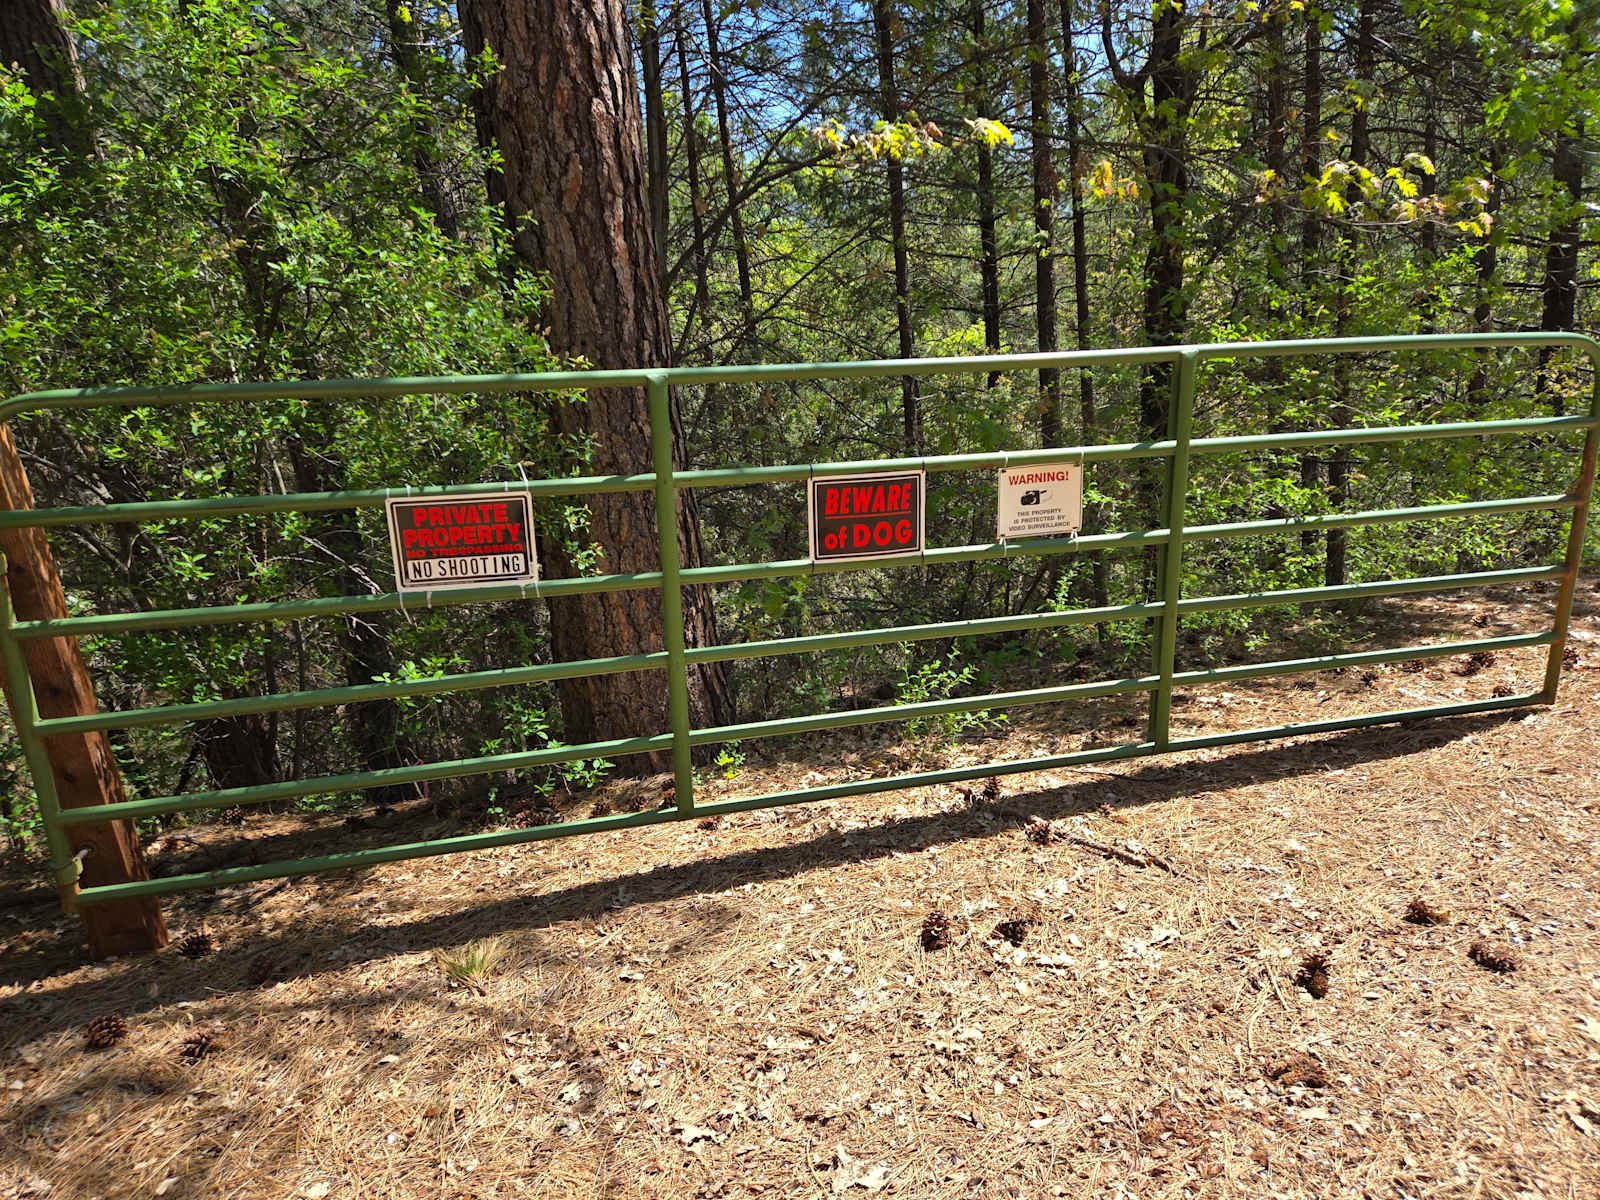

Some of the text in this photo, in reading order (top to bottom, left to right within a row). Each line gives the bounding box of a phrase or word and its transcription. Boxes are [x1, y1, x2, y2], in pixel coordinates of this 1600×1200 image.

[1008, 471, 1069, 486] WARNING!
[825, 483, 912, 514] BEWARE
[413, 504, 509, 527] PRIVATE
[1020, 516, 1055, 524] PROTECTED
[1031, 508, 1062, 516] PROPERTY
[824, 519, 912, 550] of DOG
[1028, 522, 1070, 530] SURVEILLANCE
[403, 523, 520, 548] PROPERTY
[406, 544, 523, 558] NO TRESPASSING
[412, 556, 520, 578] NO SHOOTING
